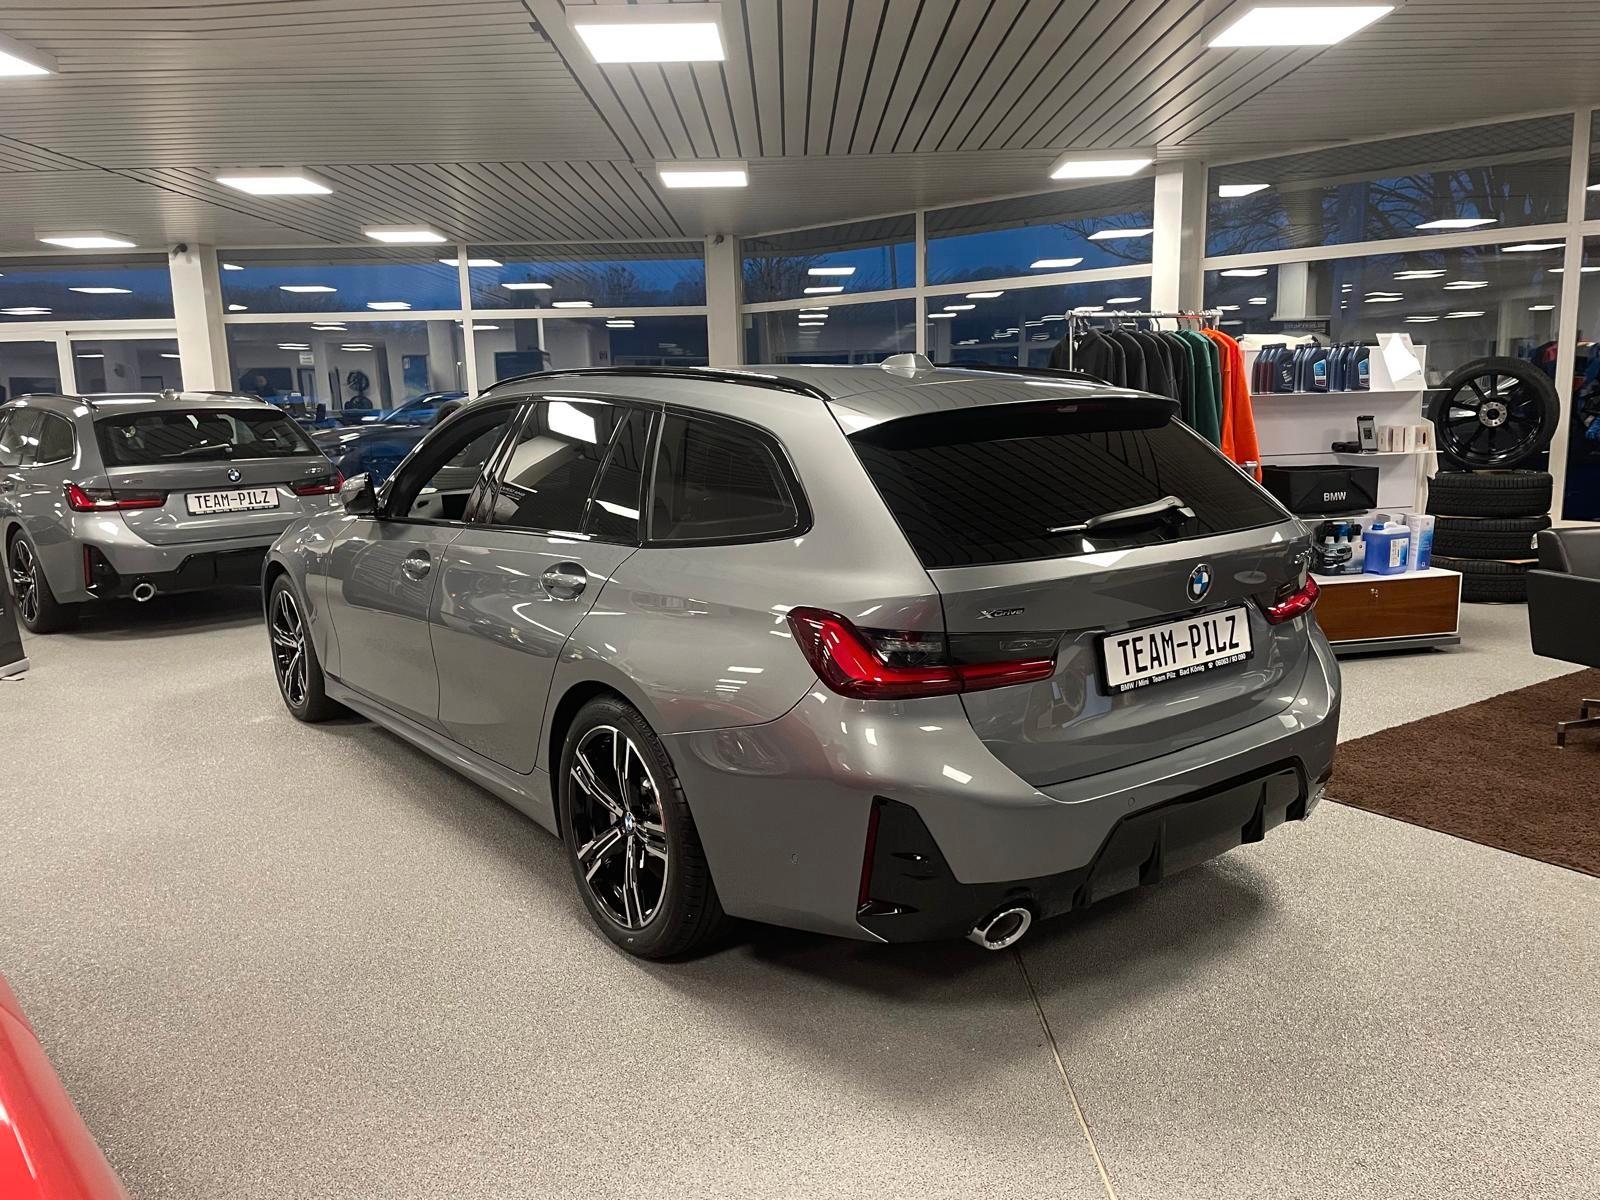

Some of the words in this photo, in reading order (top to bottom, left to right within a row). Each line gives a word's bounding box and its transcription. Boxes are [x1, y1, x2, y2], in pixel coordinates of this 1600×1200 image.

[194, 490, 270, 509] TEAM-PILZ
[1323, 491, 1347, 501] BMW
[1117, 615, 1240, 676] TEAM-PILZ
[1120, 682, 1135, 692] BMW
[1138, 678, 1150, 687] Mini
[1152, 675, 1167, 683] Team
[1179, 668, 1190, 676] Bad
[1190, 664, 1205, 673] König
